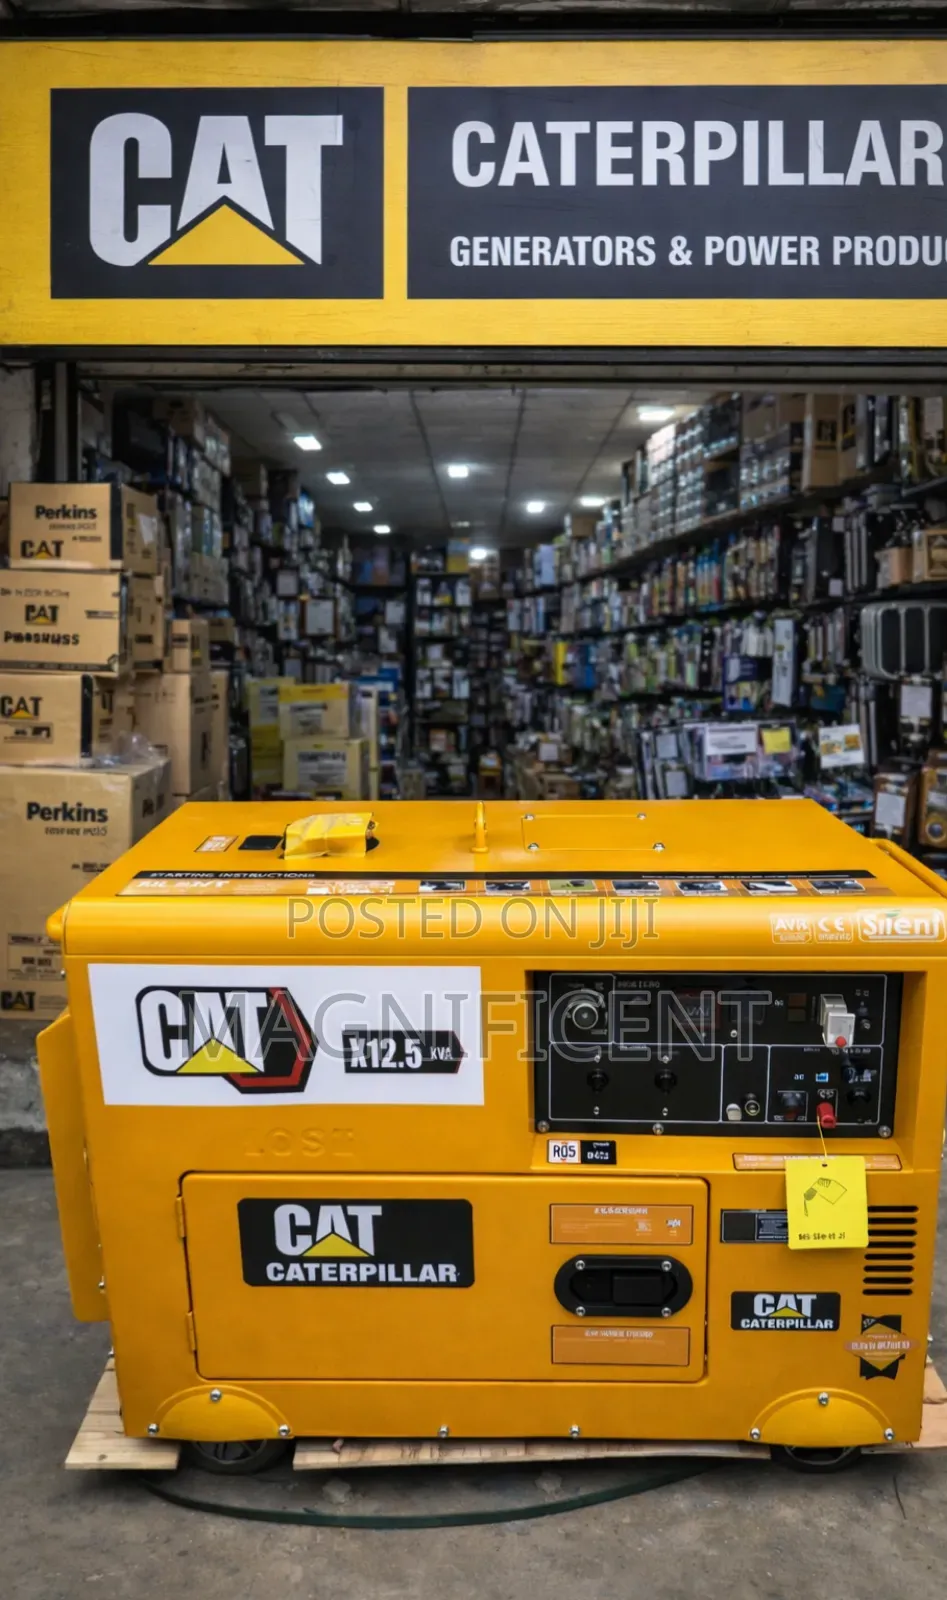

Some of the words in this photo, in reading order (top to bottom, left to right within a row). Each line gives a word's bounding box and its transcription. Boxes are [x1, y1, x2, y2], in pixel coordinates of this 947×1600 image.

[451, 119, 945, 188] CATERPILLAR
[89, 112, 343, 267] CAT
[450, 234, 656, 268] GENERATORS
[667, 235, 693, 268] &
[704, 235, 820, 267] POWER
[832, 235, 947, 266] PRODU
[35, 503, 97, 520] Perkins
[20, 539, 64, 559] CAT
[0, 695, 43, 719] CAT
[26, 801, 108, 823] Perkins
[218, 871, 316, 879] INSTRUCTIONS
[775, 916, 808, 932] AVR
[142, 988, 268, 1073] CAT
[348, 1037, 423, 1069] X12.5
[273, 1203, 382, 1257] CAT
[266, 1261, 458, 1283] CATERPILLAR
[753, 1293, 817, 1318] CAT
[740, 1318, 834, 1330] CATERPILLAR
